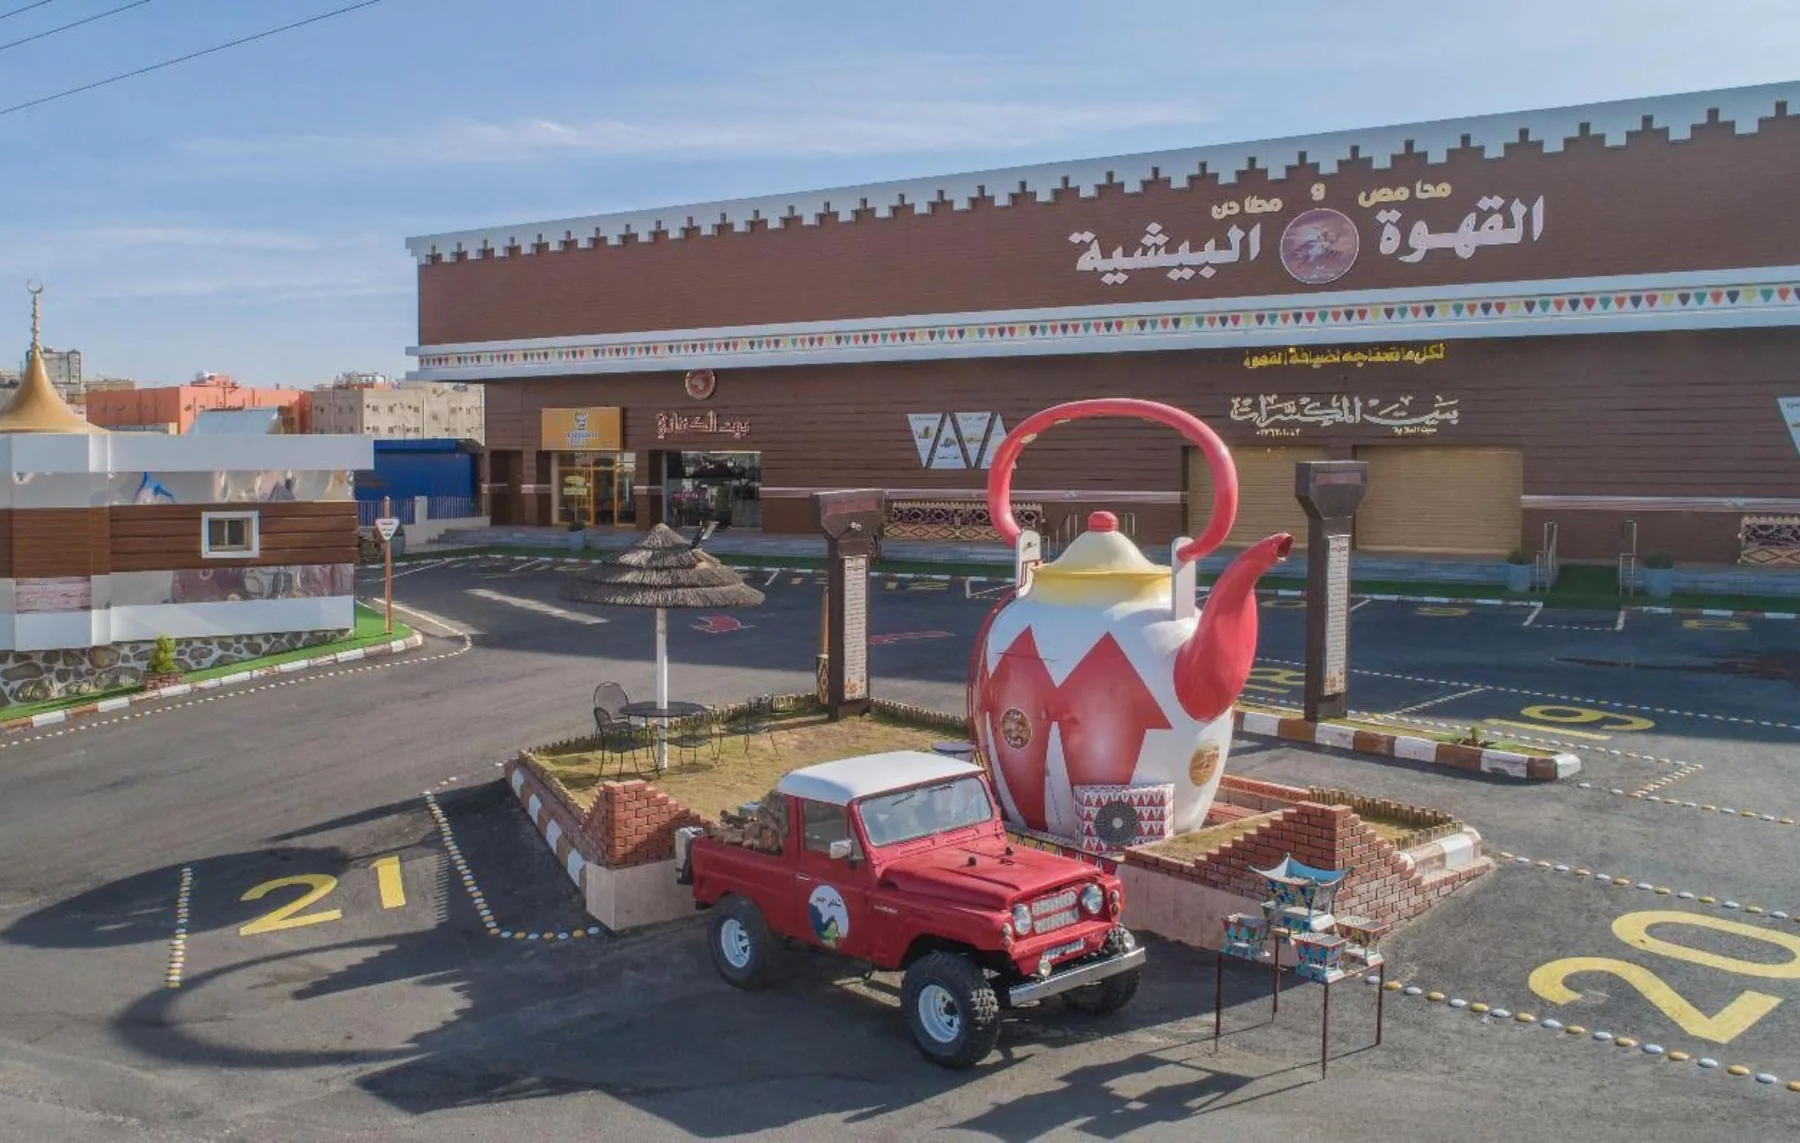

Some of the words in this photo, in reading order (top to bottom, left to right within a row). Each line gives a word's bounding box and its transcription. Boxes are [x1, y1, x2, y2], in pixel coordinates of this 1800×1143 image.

[1211, 194, 1284, 219] مطاحن
[1375, 194, 1546, 264] القهوة
[1068, 221, 1262, 287] البيشية
[239, 855, 406, 937] 21
[1529, 910, 1800, 1043] 20
